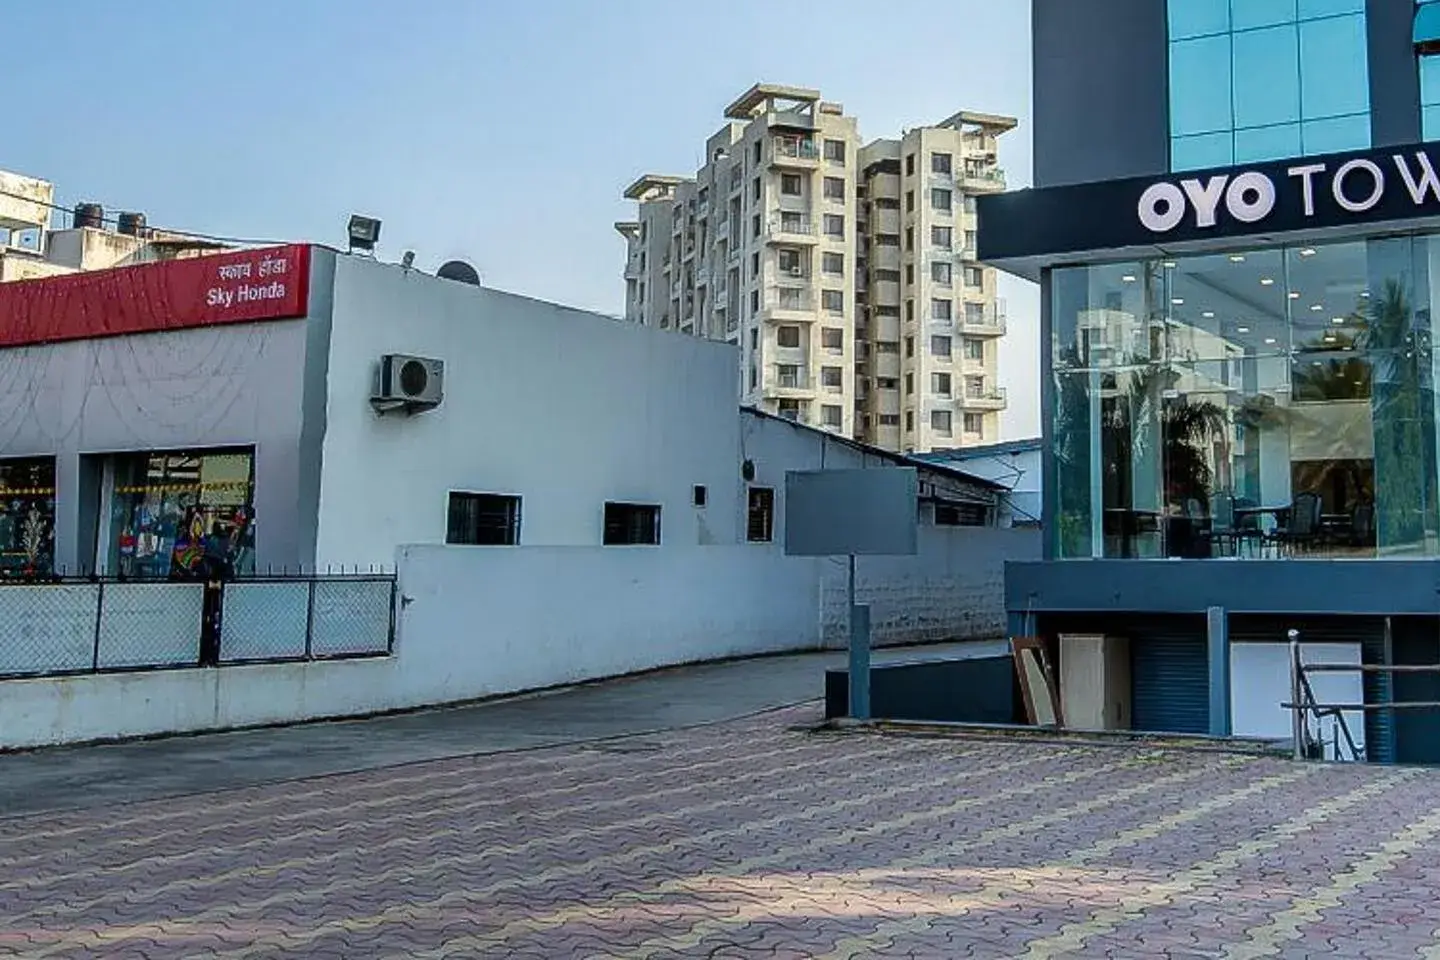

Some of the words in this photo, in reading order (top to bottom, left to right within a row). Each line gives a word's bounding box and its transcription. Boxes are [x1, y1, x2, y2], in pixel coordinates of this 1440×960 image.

[1137, 171, 1277, 233] OYO
[206, 287, 234, 308] Sky
[237, 281, 286, 303] Honda
